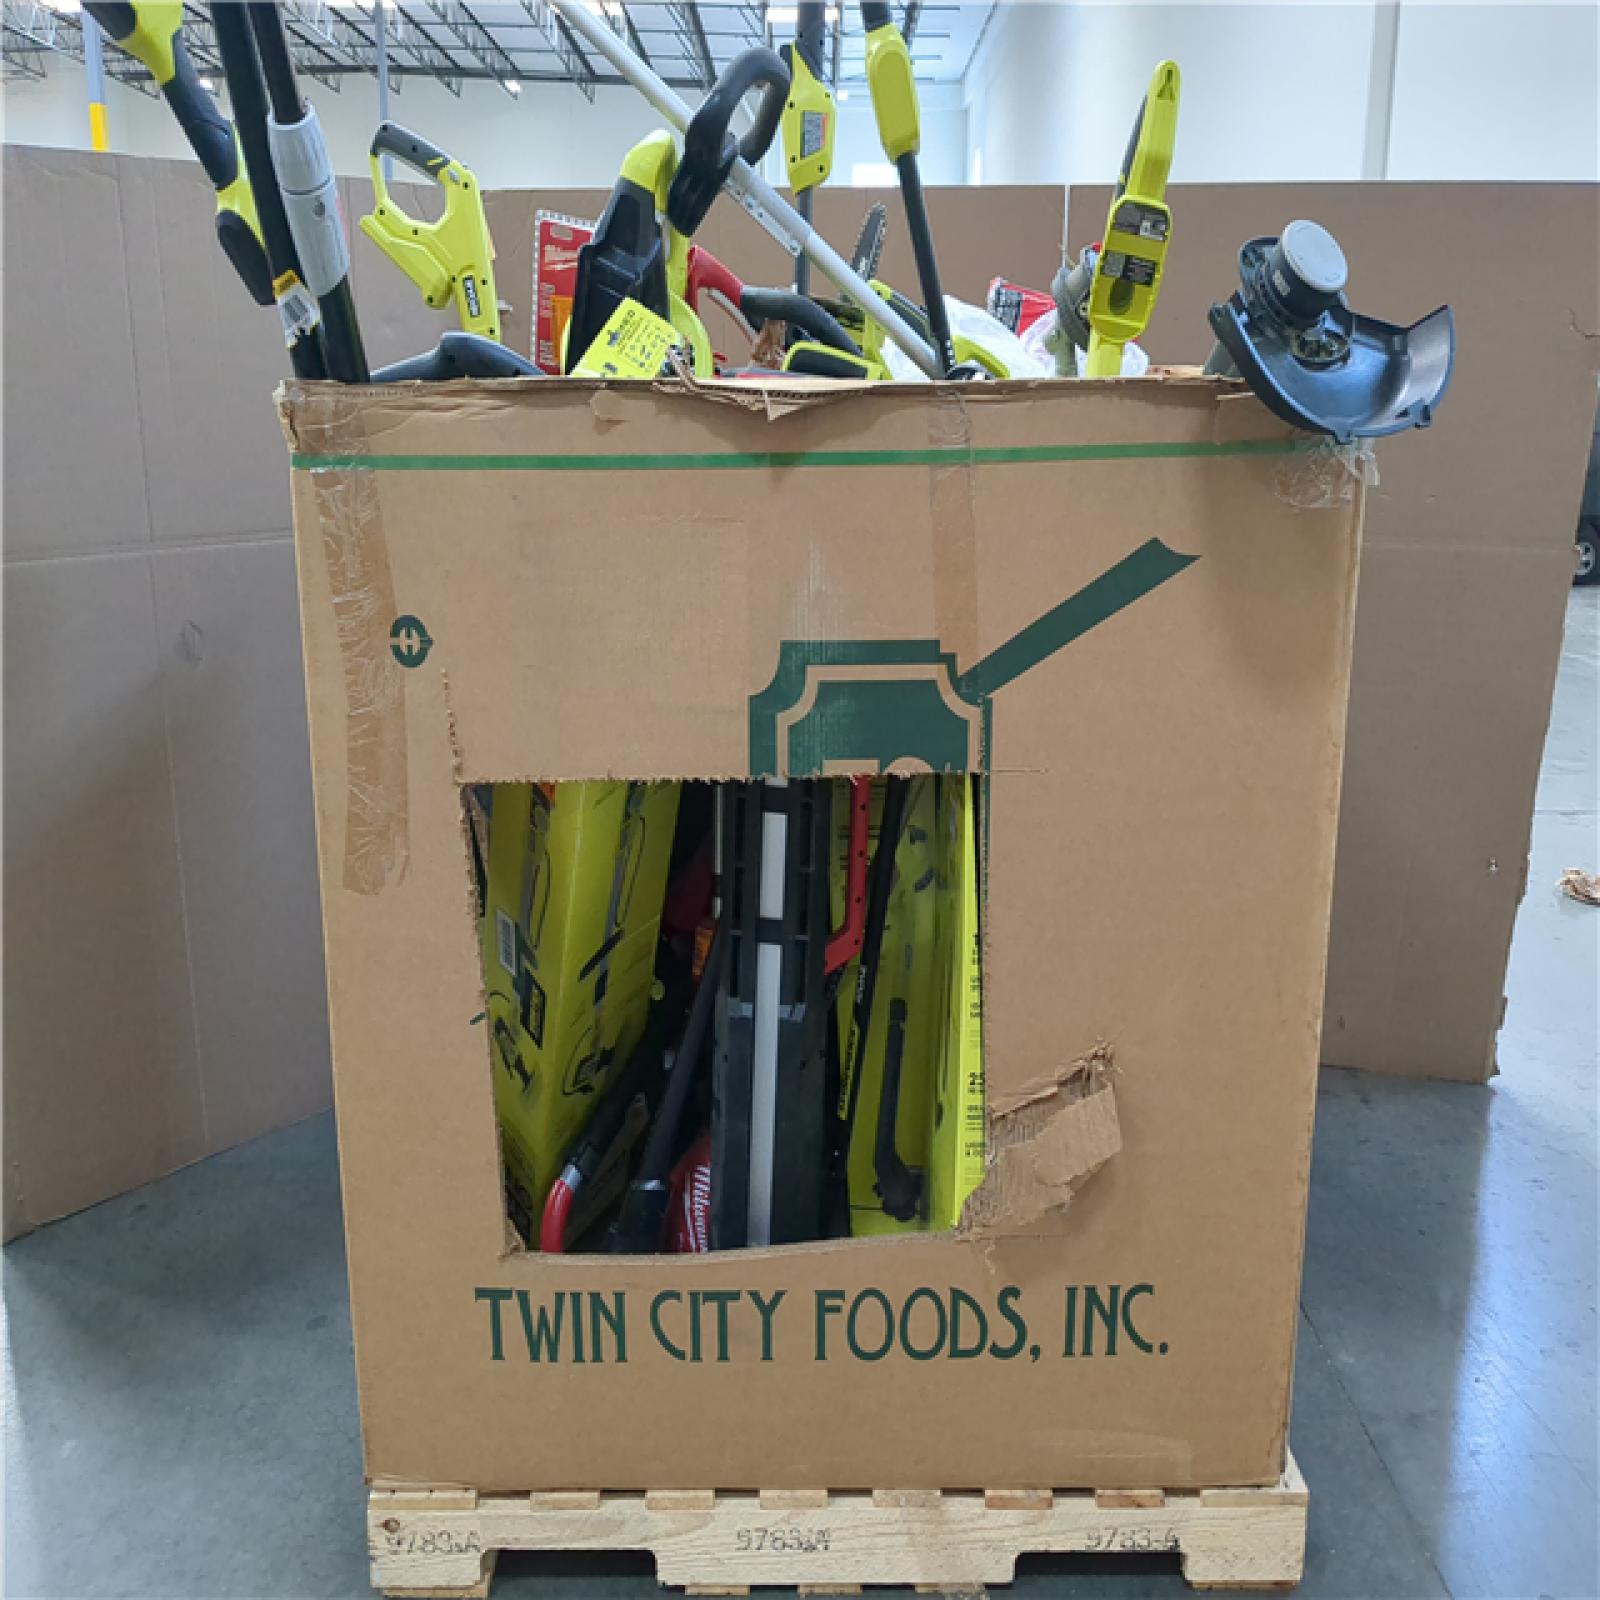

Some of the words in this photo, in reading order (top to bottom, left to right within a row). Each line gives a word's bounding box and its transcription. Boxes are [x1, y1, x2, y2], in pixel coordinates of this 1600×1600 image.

[474, 1287, 627, 1364] TWIN
[650, 1289, 787, 1362] CITY
[815, 1286, 1041, 1361] FOODS,
[1064, 1284, 1169, 1357] INC.
